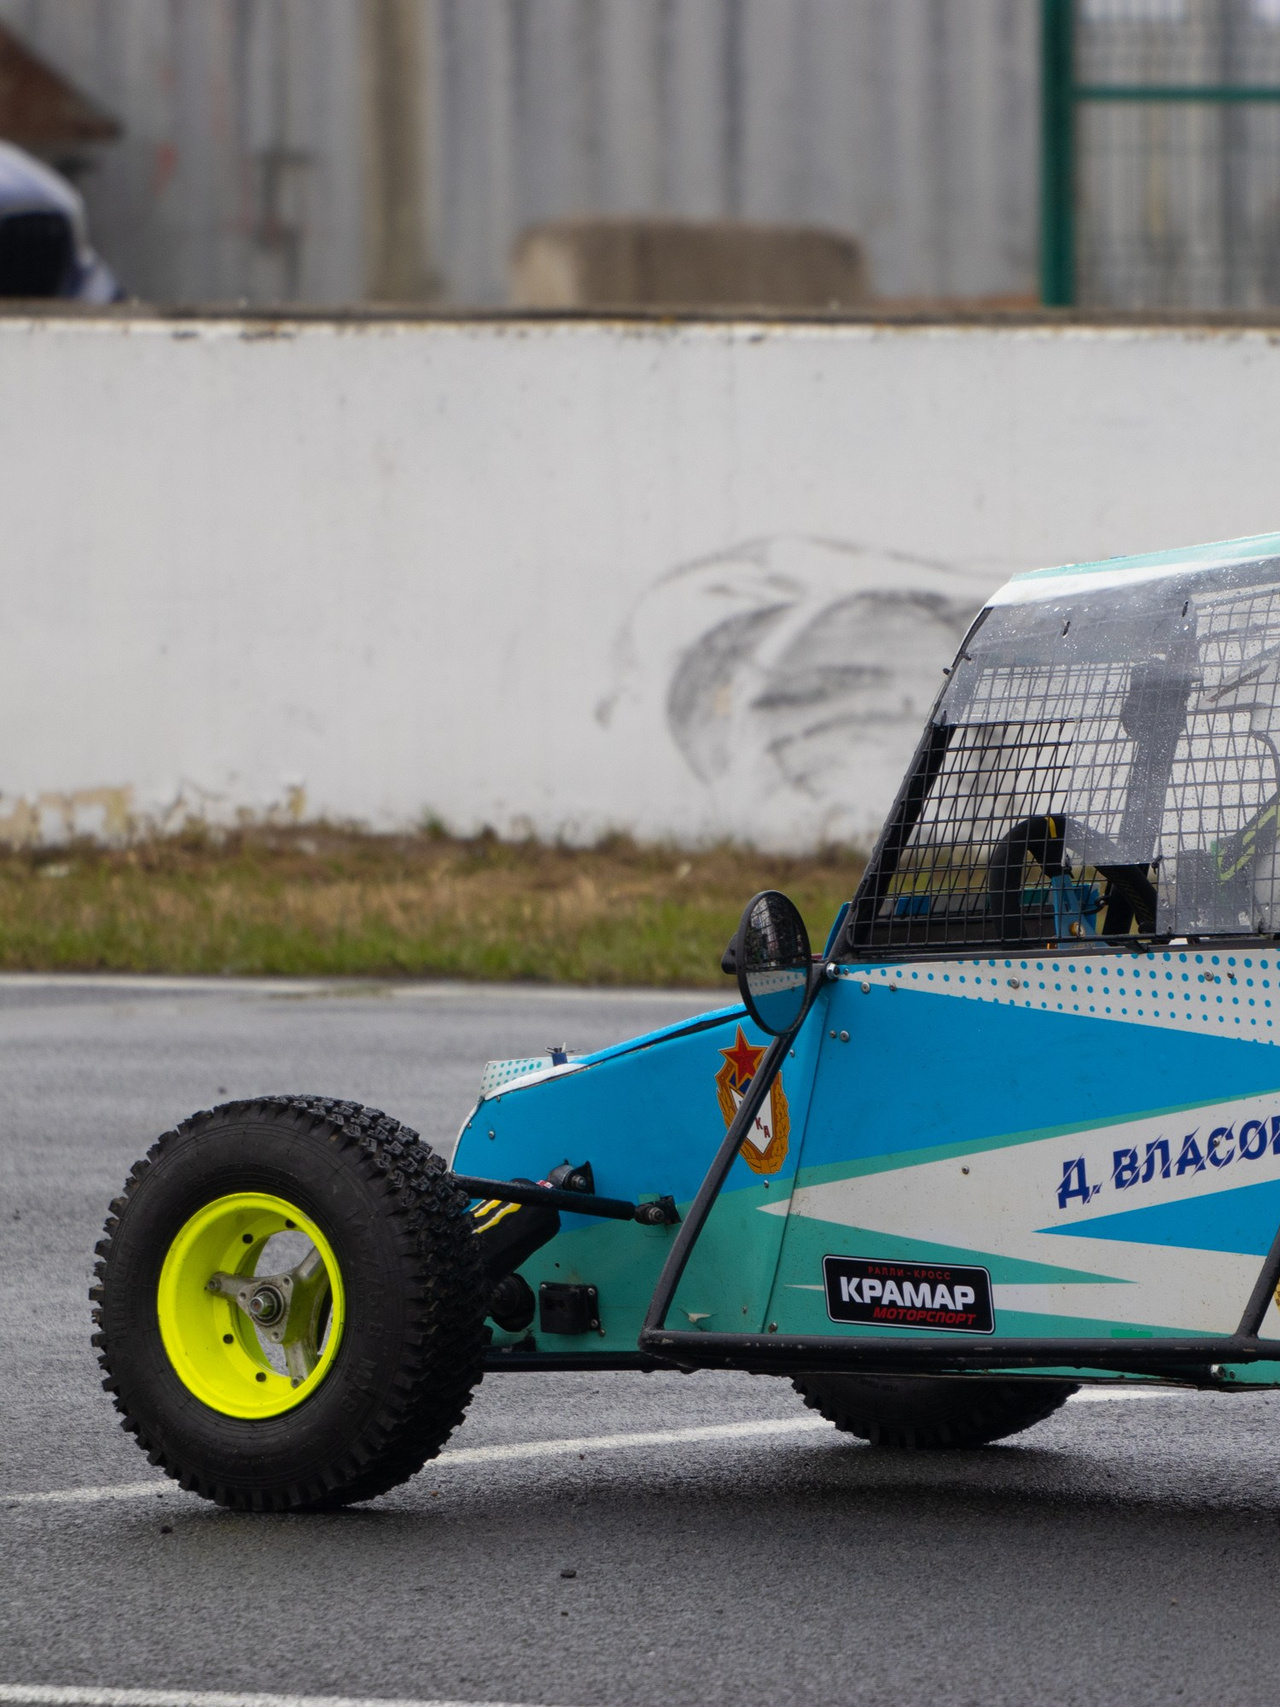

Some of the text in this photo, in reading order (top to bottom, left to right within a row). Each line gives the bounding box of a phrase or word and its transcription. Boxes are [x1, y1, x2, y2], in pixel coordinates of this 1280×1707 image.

[1056, 1157, 1103, 1210] Д.
[840, 1276, 976, 1311] КРАМАР
[873, 1306, 976, 1325] МОТОРСПОРТ
